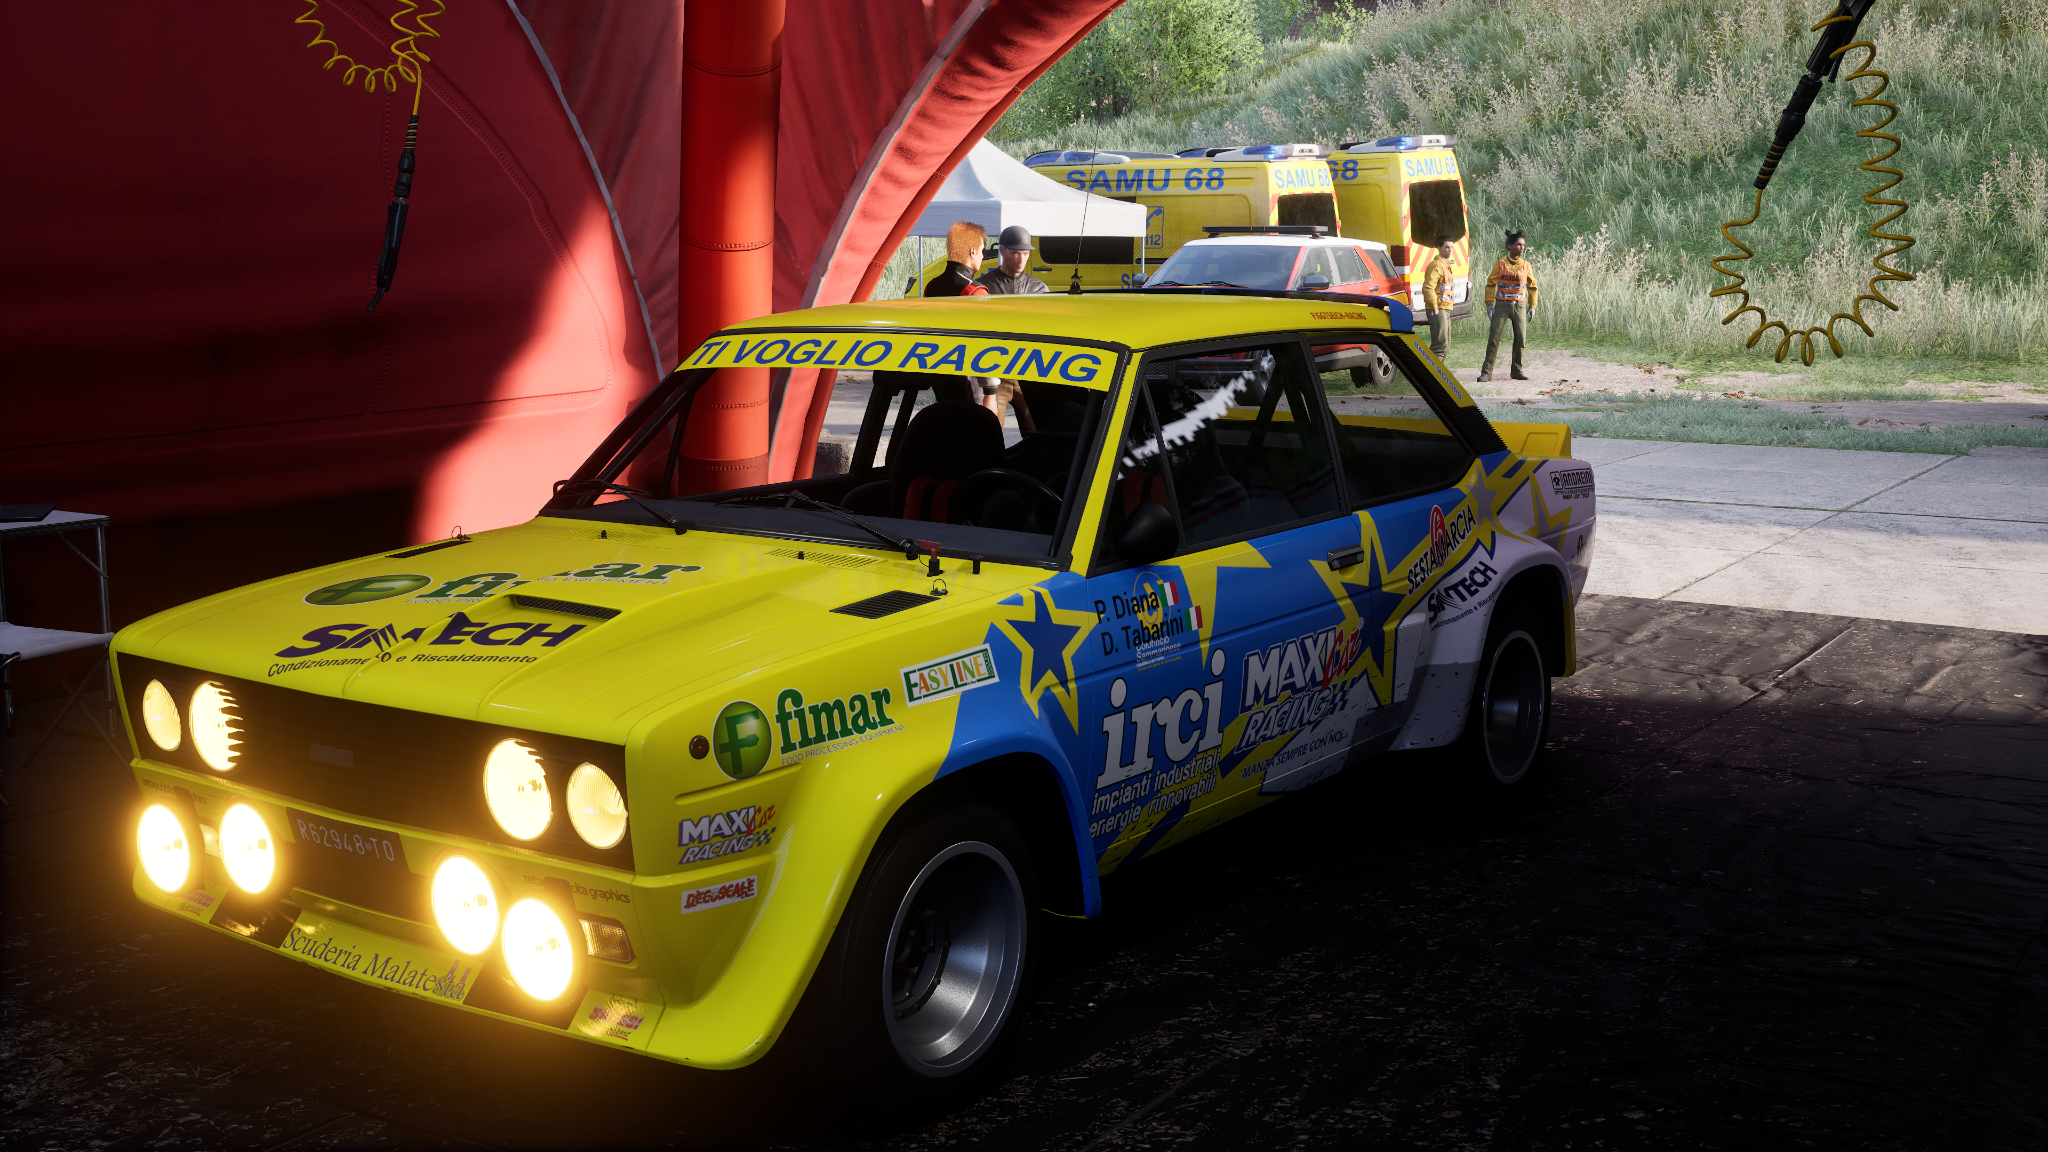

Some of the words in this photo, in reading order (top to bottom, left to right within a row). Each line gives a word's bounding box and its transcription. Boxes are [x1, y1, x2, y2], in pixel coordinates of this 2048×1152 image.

[1066, 169, 1171, 192] SAMU
[1184, 168, 1225, 191] 68
[1274, 168, 1315, 189] SAMU
[1318, 167, 1331, 188] 68
[1405, 157, 1443, 177] SAMU
[1444, 156, 1457, 174] 68
[692, 341, 728, 366] TI
[731, 339, 894, 366] VOGLIO
[898, 341, 1101, 383] RACING
[1407, 502, 1477, 597] SESTAMARCIA
[1094, 599, 1110, 625] P.
[1112, 591, 1160, 619] Diana
[1101, 631, 1118, 656] D.
[1121, 609, 1184, 649] Tabarini
[396, 655, 407, 663] e
[411, 654, 538, 663] Riscaldamento
[1239, 625, 1338, 716] MAXI
[774, 687, 897, 756] fimar
[1095, 647, 1226, 792] irci
[1234, 686, 1331, 754] RACING
[781, 752, 804, 767] FOOD
[805, 738, 859, 759] PROCESSING
[858, 724, 907, 743] EQUIPMENT
[1275, 744, 1309, 766] SEMPRE
[1309, 734, 1328, 752] CON
[1091, 772, 1152, 816] impianti
[1153, 747, 1222, 793] industriali
[678, 805, 756, 847] MAXI
[1089, 802, 1142, 839] energie
[1148, 770, 1218, 818] rinnovabili
[678, 834, 756, 865] RACING
[589, 887, 631, 903] graphics
[283, 928, 362, 972] Scuderia
[361, 953, 467, 1001] Malatesta
